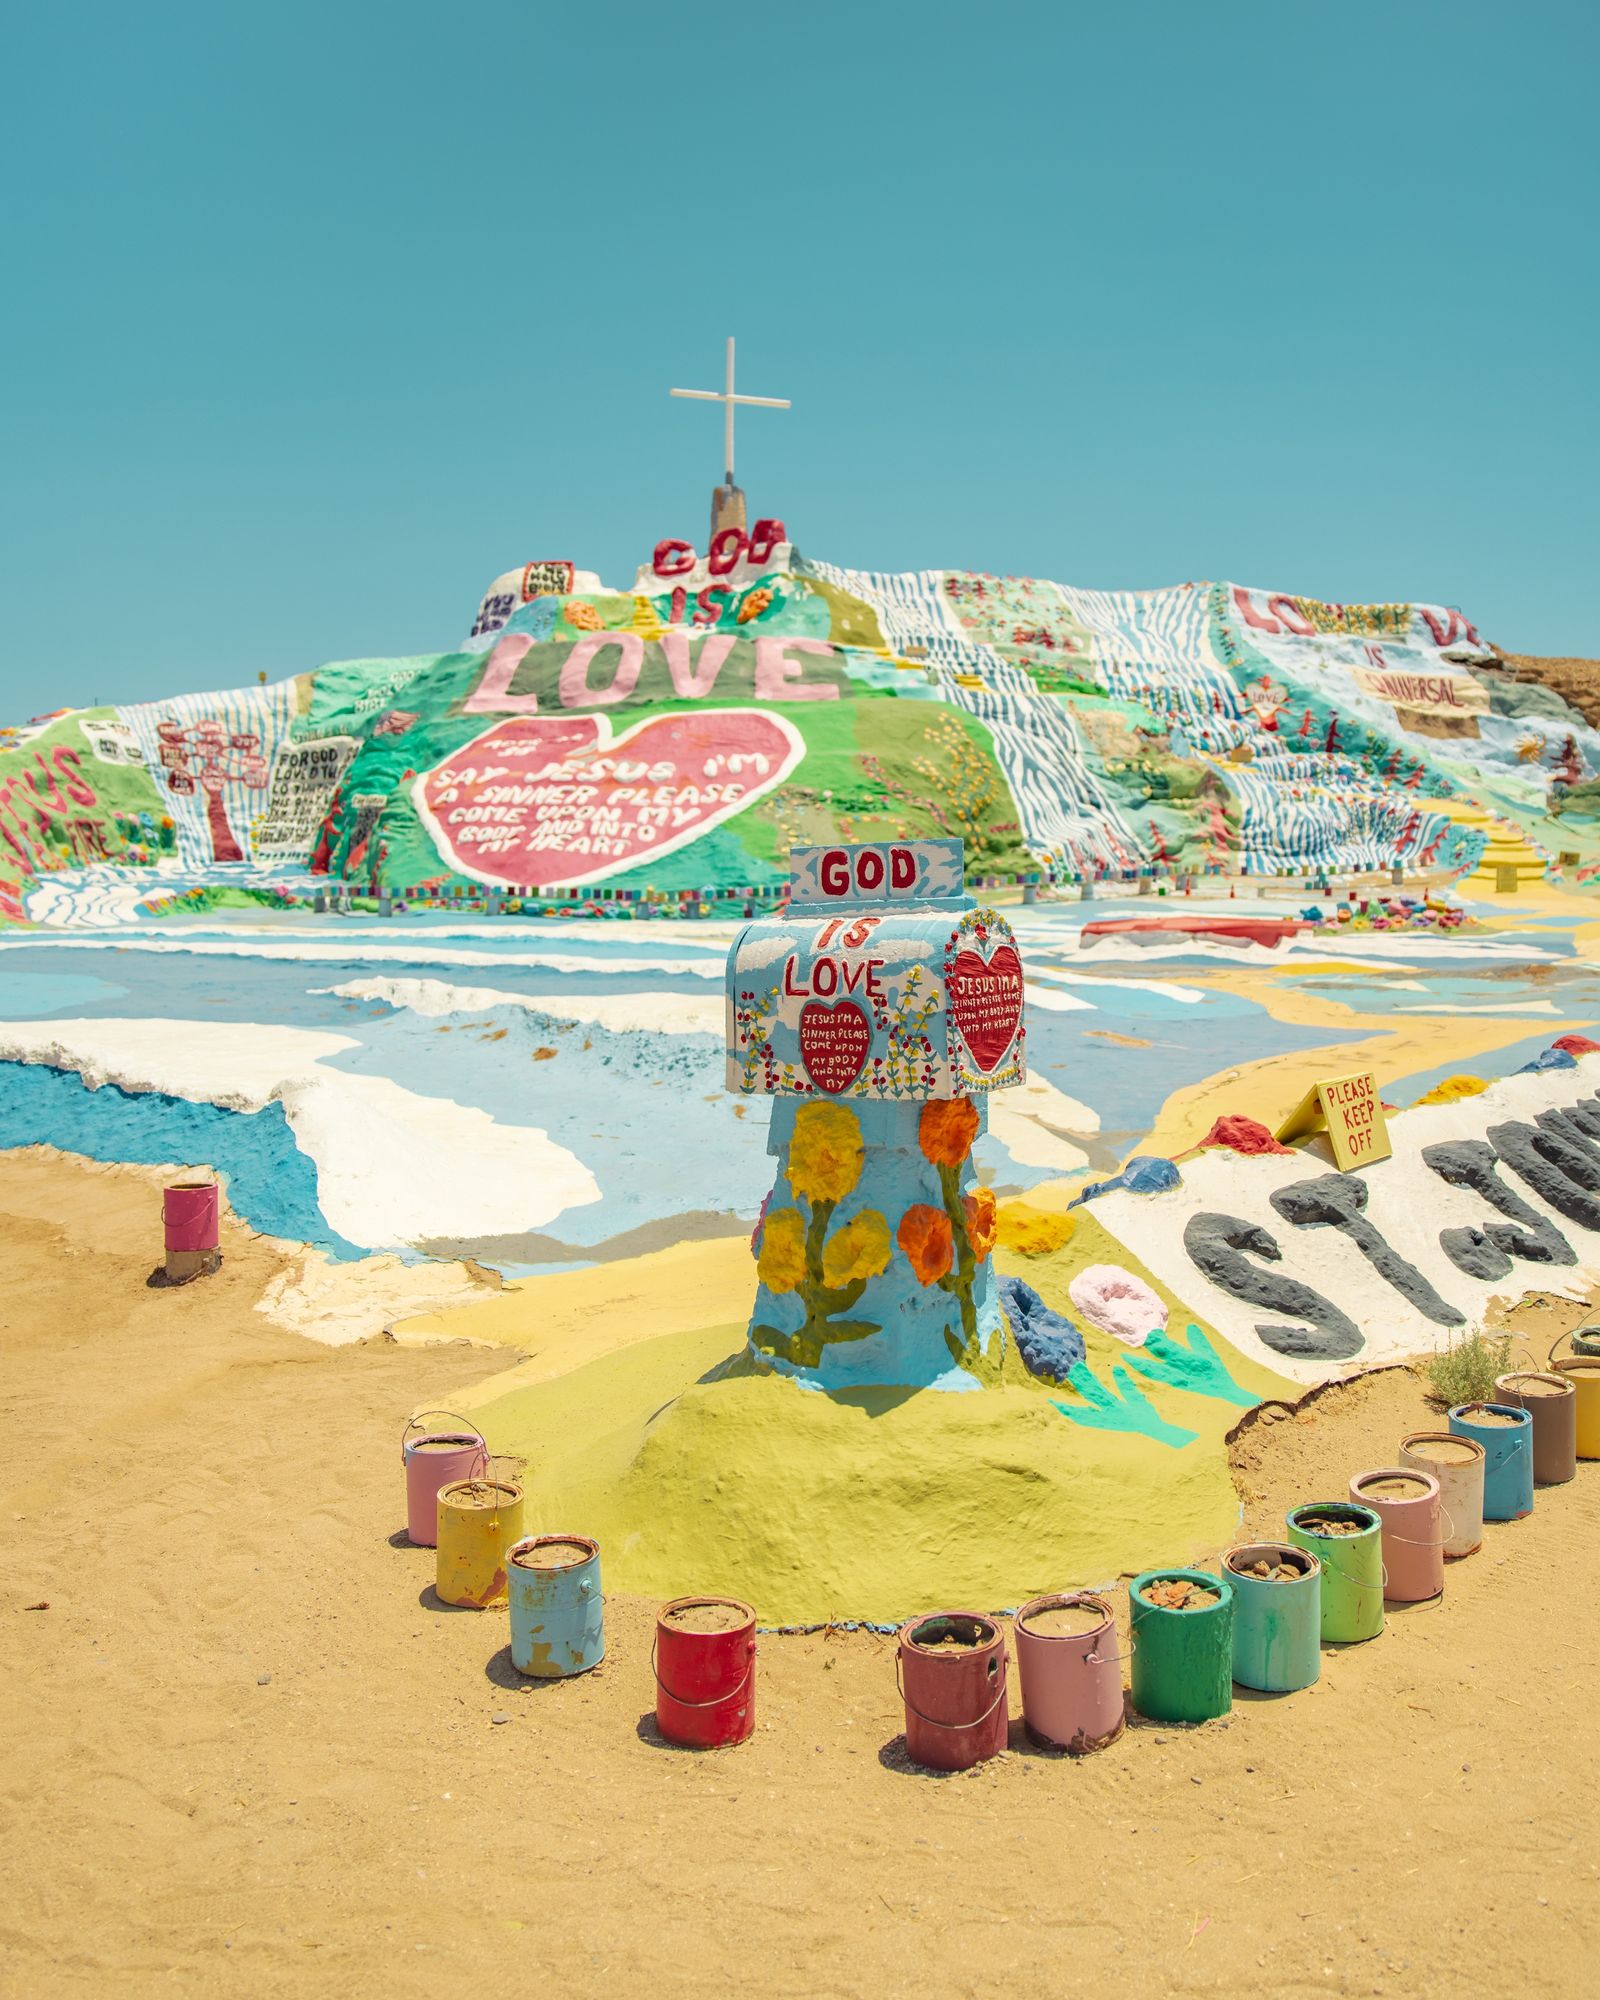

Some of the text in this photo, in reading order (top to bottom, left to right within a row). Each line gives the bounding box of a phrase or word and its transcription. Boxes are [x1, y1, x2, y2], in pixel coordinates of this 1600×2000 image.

[652, 518, 786, 577] GOD
[669, 584, 734, 625] IS
[1364, 645, 1388, 670] IS
[463, 632, 841, 714] LOVE
[1364, 673, 1465, 708] UNIVERSAL
[279, 751, 310, 768] FOR
[311, 748, 338, 765] GOD
[432, 753, 770, 788] SAY JESUS I'M
[434, 783, 746, 807] A SINNER PLEASE
[447, 805, 702, 828] COME UPON MY
[456, 819, 657, 844] BODY AND INTO
[476, 834, 632, 856] MY HEART
[821, 849, 916, 896] GOD
[817, 917, 881, 948] IS
[785, 955, 886, 998] LOVE
[957, 976, 995, 996] JESUS
[1011, 974, 1019, 990] A
[952, 991, 1021, 1009] SINNER PLEASE COME
[804, 1013, 863, 1025] JESUS I'M A
[958, 1004, 1020, 1021] UPON MY BODY AND
[801, 1028, 869, 1040] SINNER PLEASE
[963, 1024, 980, 1034] INTO
[982, 1022, 992, 1032] MY
[804, 1040, 863, 1052] COME UPON
[811, 1054, 858, 1067] MY BODY
[812, 1066, 857, 1077] AND INTO
[826, 1078, 845, 1089] MY
[1326, 1076, 1374, 1108] PLEASE
[1343, 1099, 1375, 1130] KEEP
[1348, 1128, 1372, 1156] OFF
